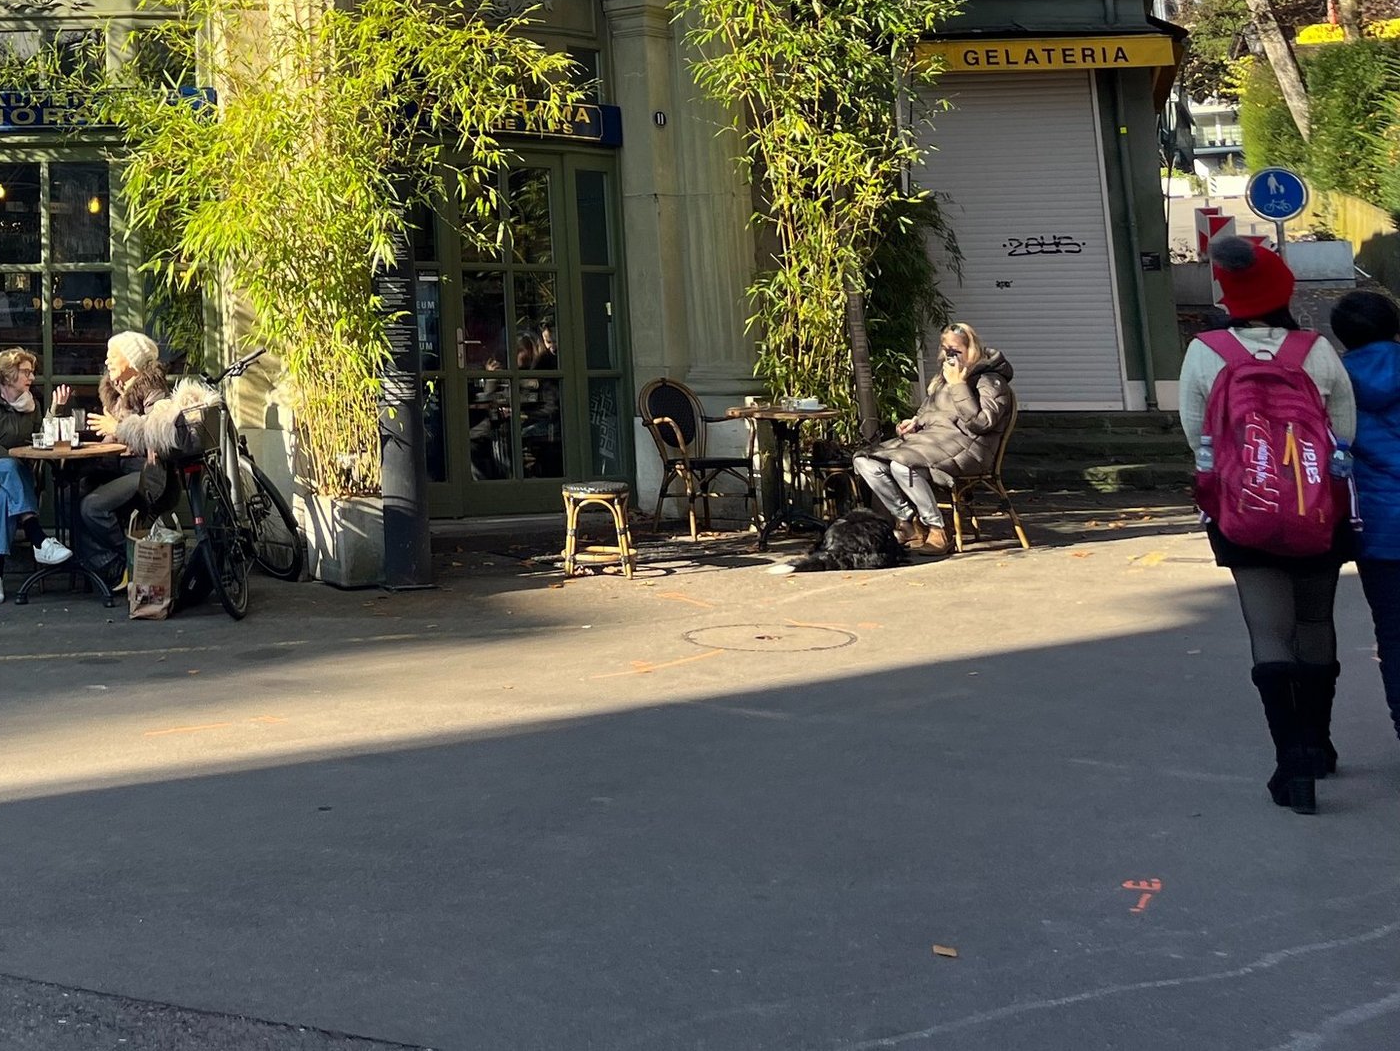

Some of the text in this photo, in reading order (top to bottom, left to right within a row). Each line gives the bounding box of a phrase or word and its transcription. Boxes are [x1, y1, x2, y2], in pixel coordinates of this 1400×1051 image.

[963, 46, 1129, 67] GELATERIA
[657, 113, 664, 125] 11
[1298, 437, 1322, 485] safari
